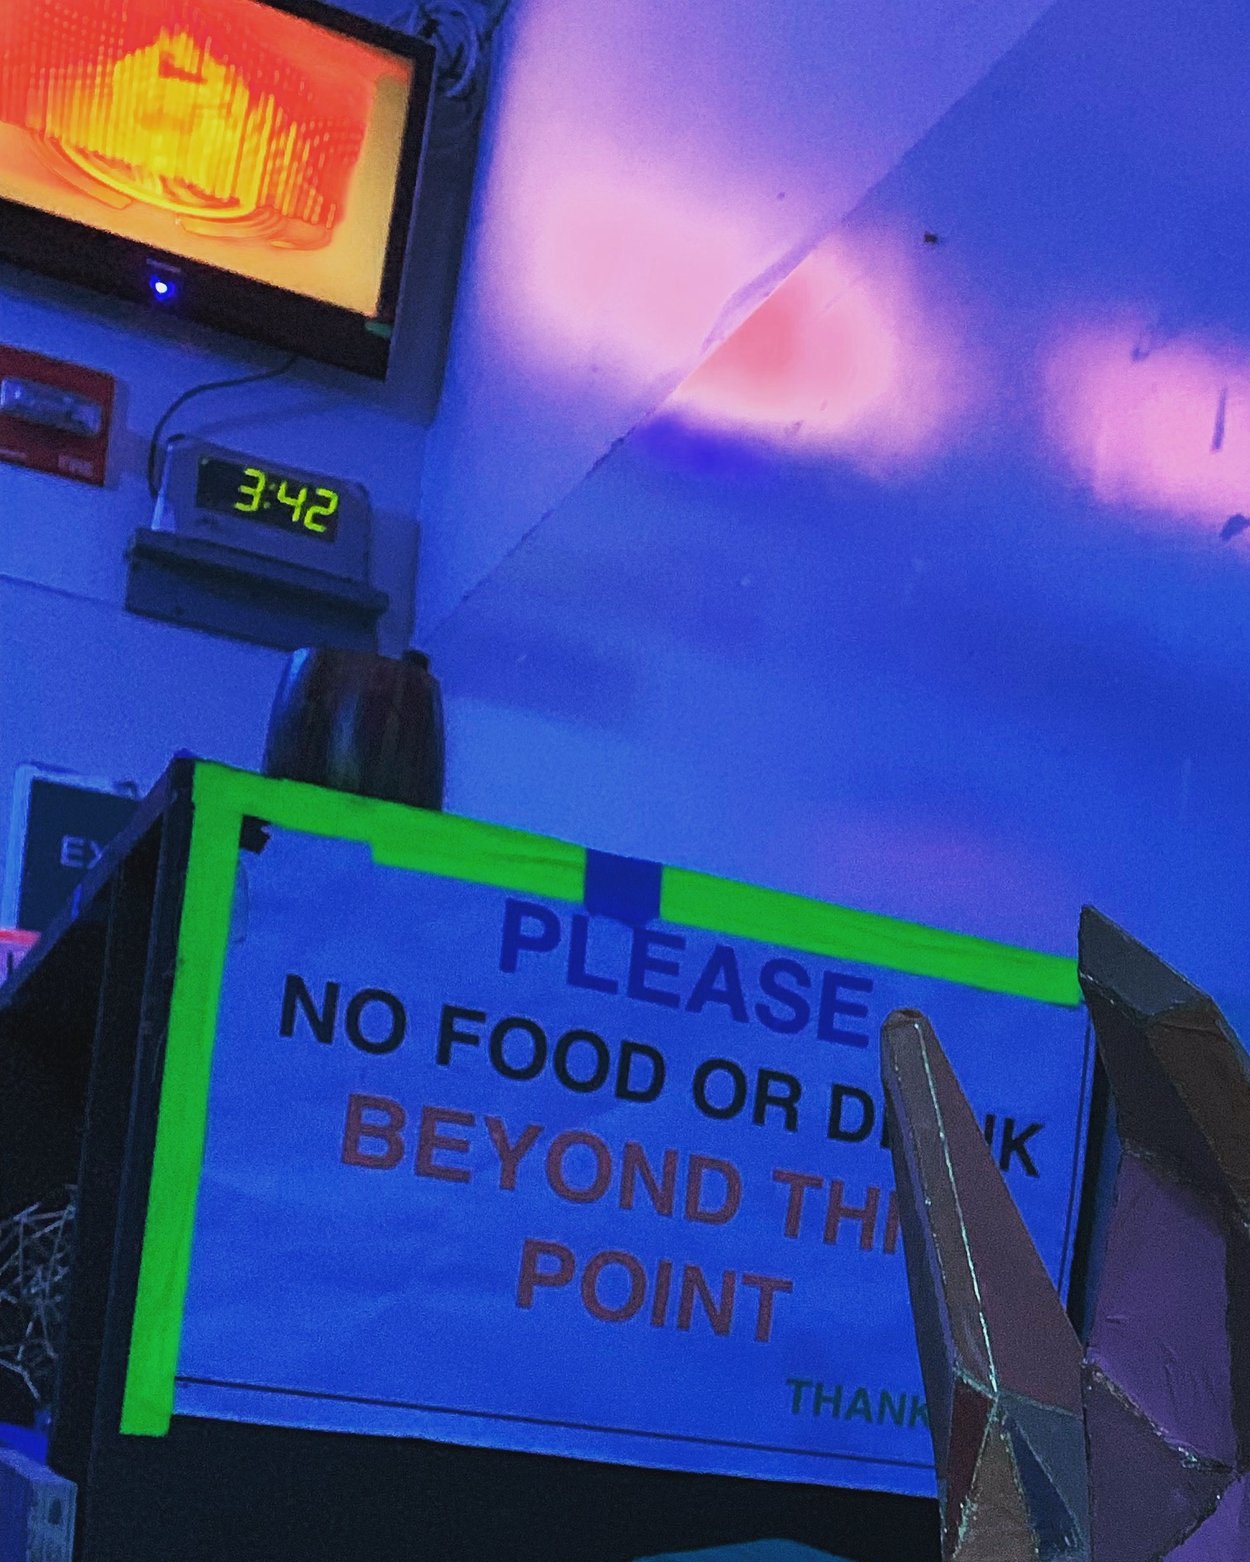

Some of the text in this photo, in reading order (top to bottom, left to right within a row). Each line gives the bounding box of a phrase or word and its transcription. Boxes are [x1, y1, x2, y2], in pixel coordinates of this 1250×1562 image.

[234, 468, 338, 532] 3:42
[60, 835, 108, 869] EX
[500, 898, 874, 1048] PLEASE
[279, 973, 407, 1054] NO
[435, 1003, 666, 1103] FOOD
[692, 1058, 803, 1133] OR
[340, 1092, 742, 1226] BEYOND
[772, 1169, 901, 1255] THI
[515, 1237, 793, 1342] POINT
[786, 1377, 929, 1428] THANK
